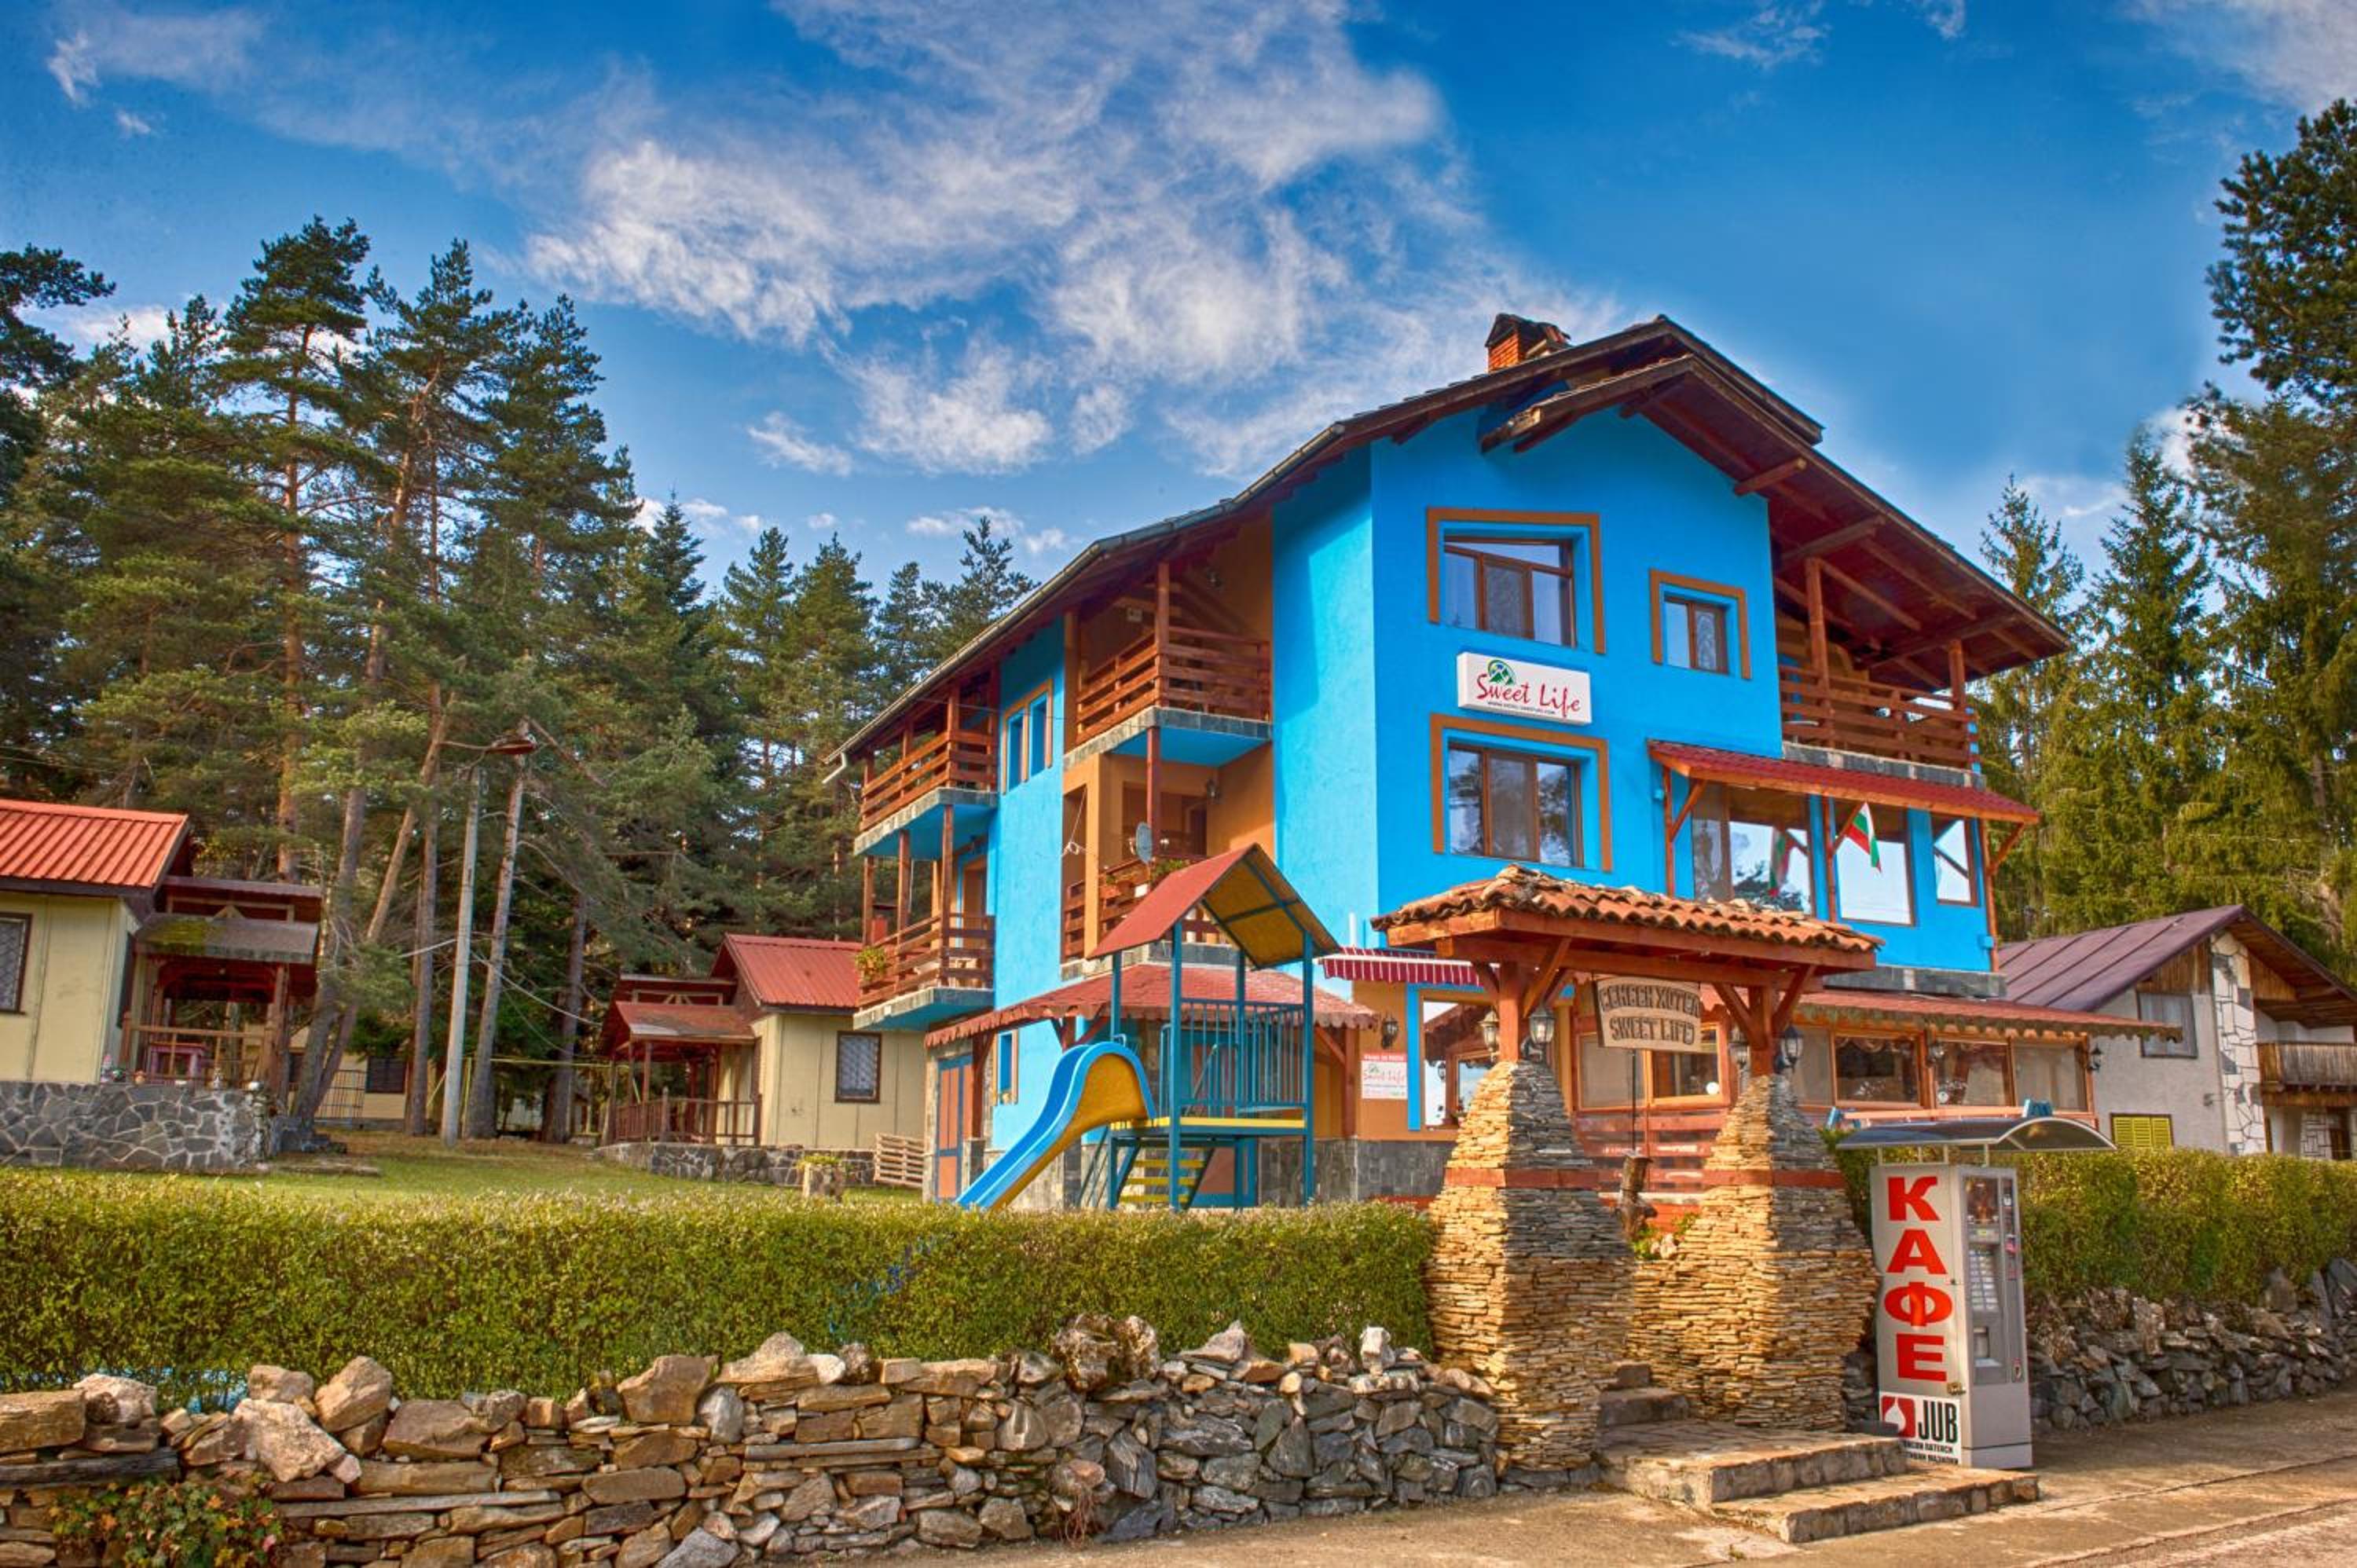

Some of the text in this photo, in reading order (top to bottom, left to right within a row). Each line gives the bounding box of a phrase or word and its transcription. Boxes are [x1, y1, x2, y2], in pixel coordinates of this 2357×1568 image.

[1475, 673, 1531, 704] Sweet
[1539, 683, 1582, 719] Life
[1609, 1017, 1695, 1046] SWEET LIFE
[1883, 1176, 1954, 1383] КАФЕ
[1918, 1399, 1958, 1444] JUB
